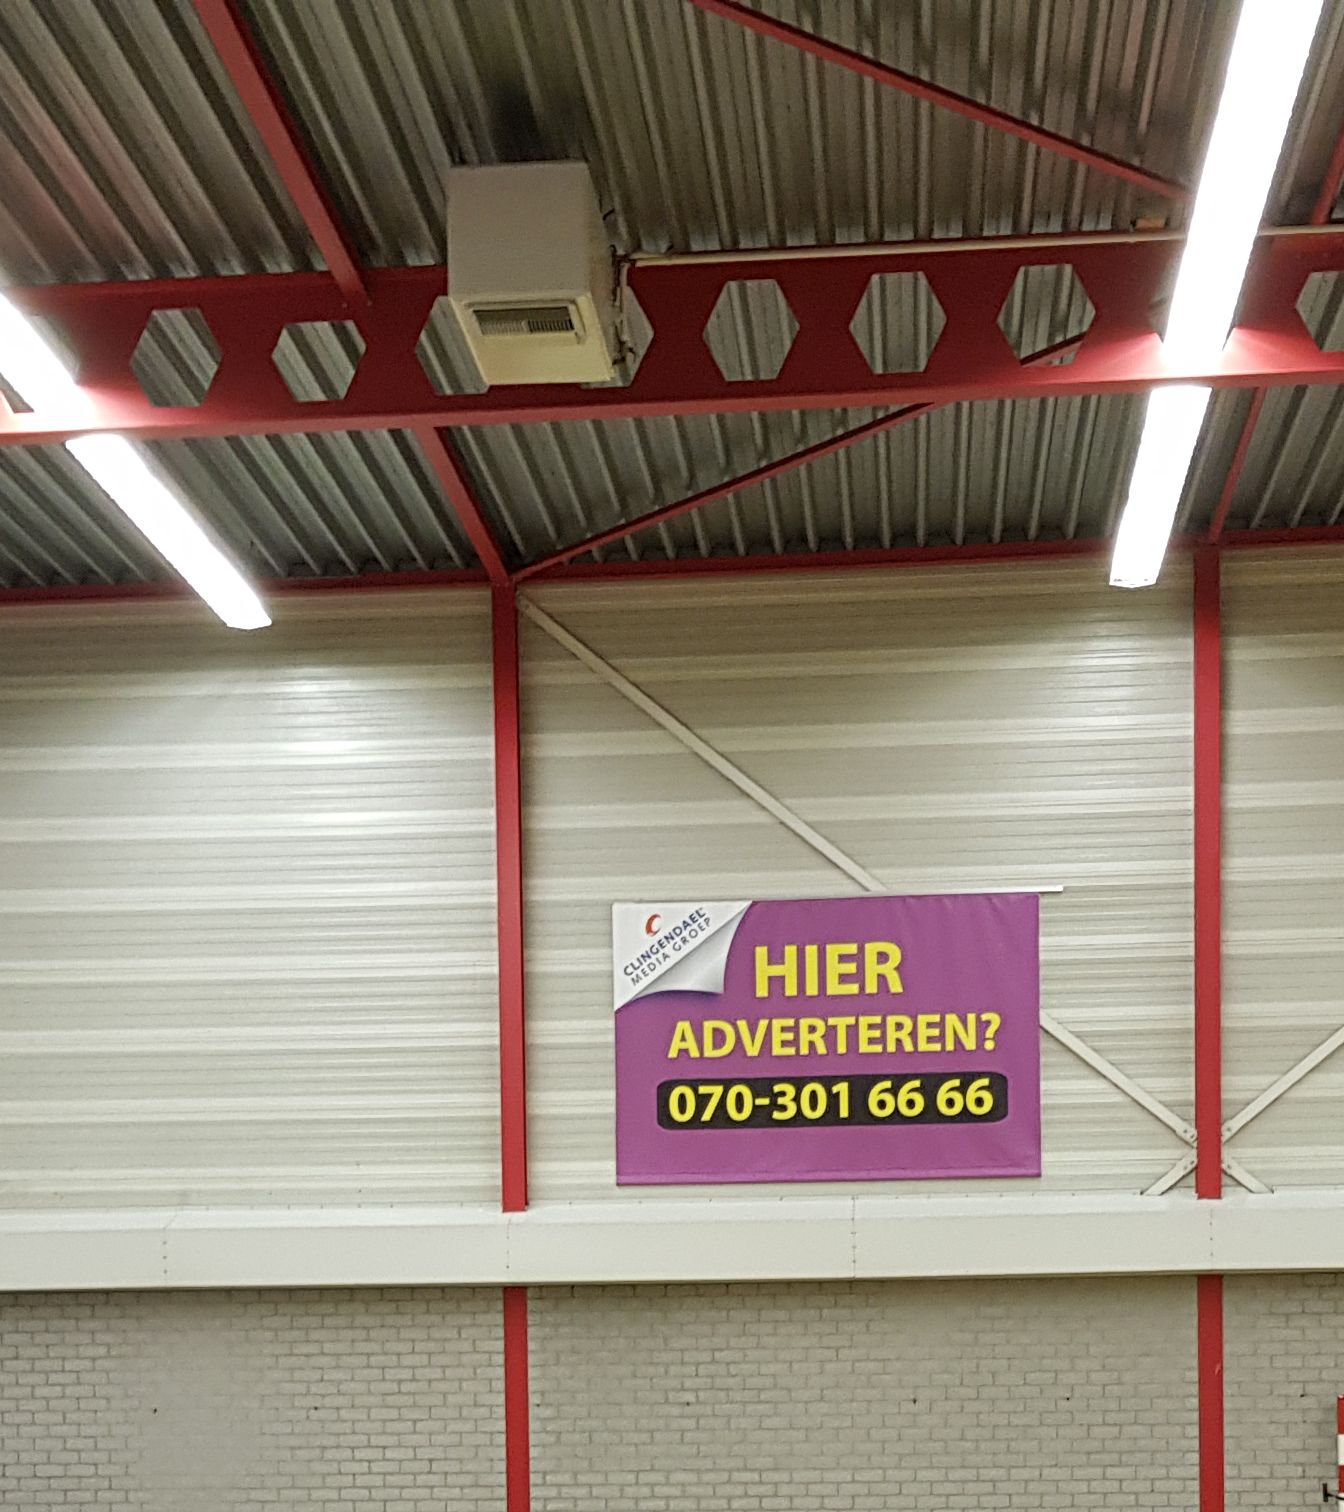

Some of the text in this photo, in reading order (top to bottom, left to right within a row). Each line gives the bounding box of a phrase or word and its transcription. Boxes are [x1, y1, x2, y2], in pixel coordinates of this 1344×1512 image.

[623, 909, 706, 977] CLINGENDAEL
[631, 917, 711, 986] MEDIA GROEP
[755, 941, 904, 998] HIER
[668, 1011, 1001, 1059] ADVERTEREN?
[668, 1077, 994, 1123] 070-301 66 66
